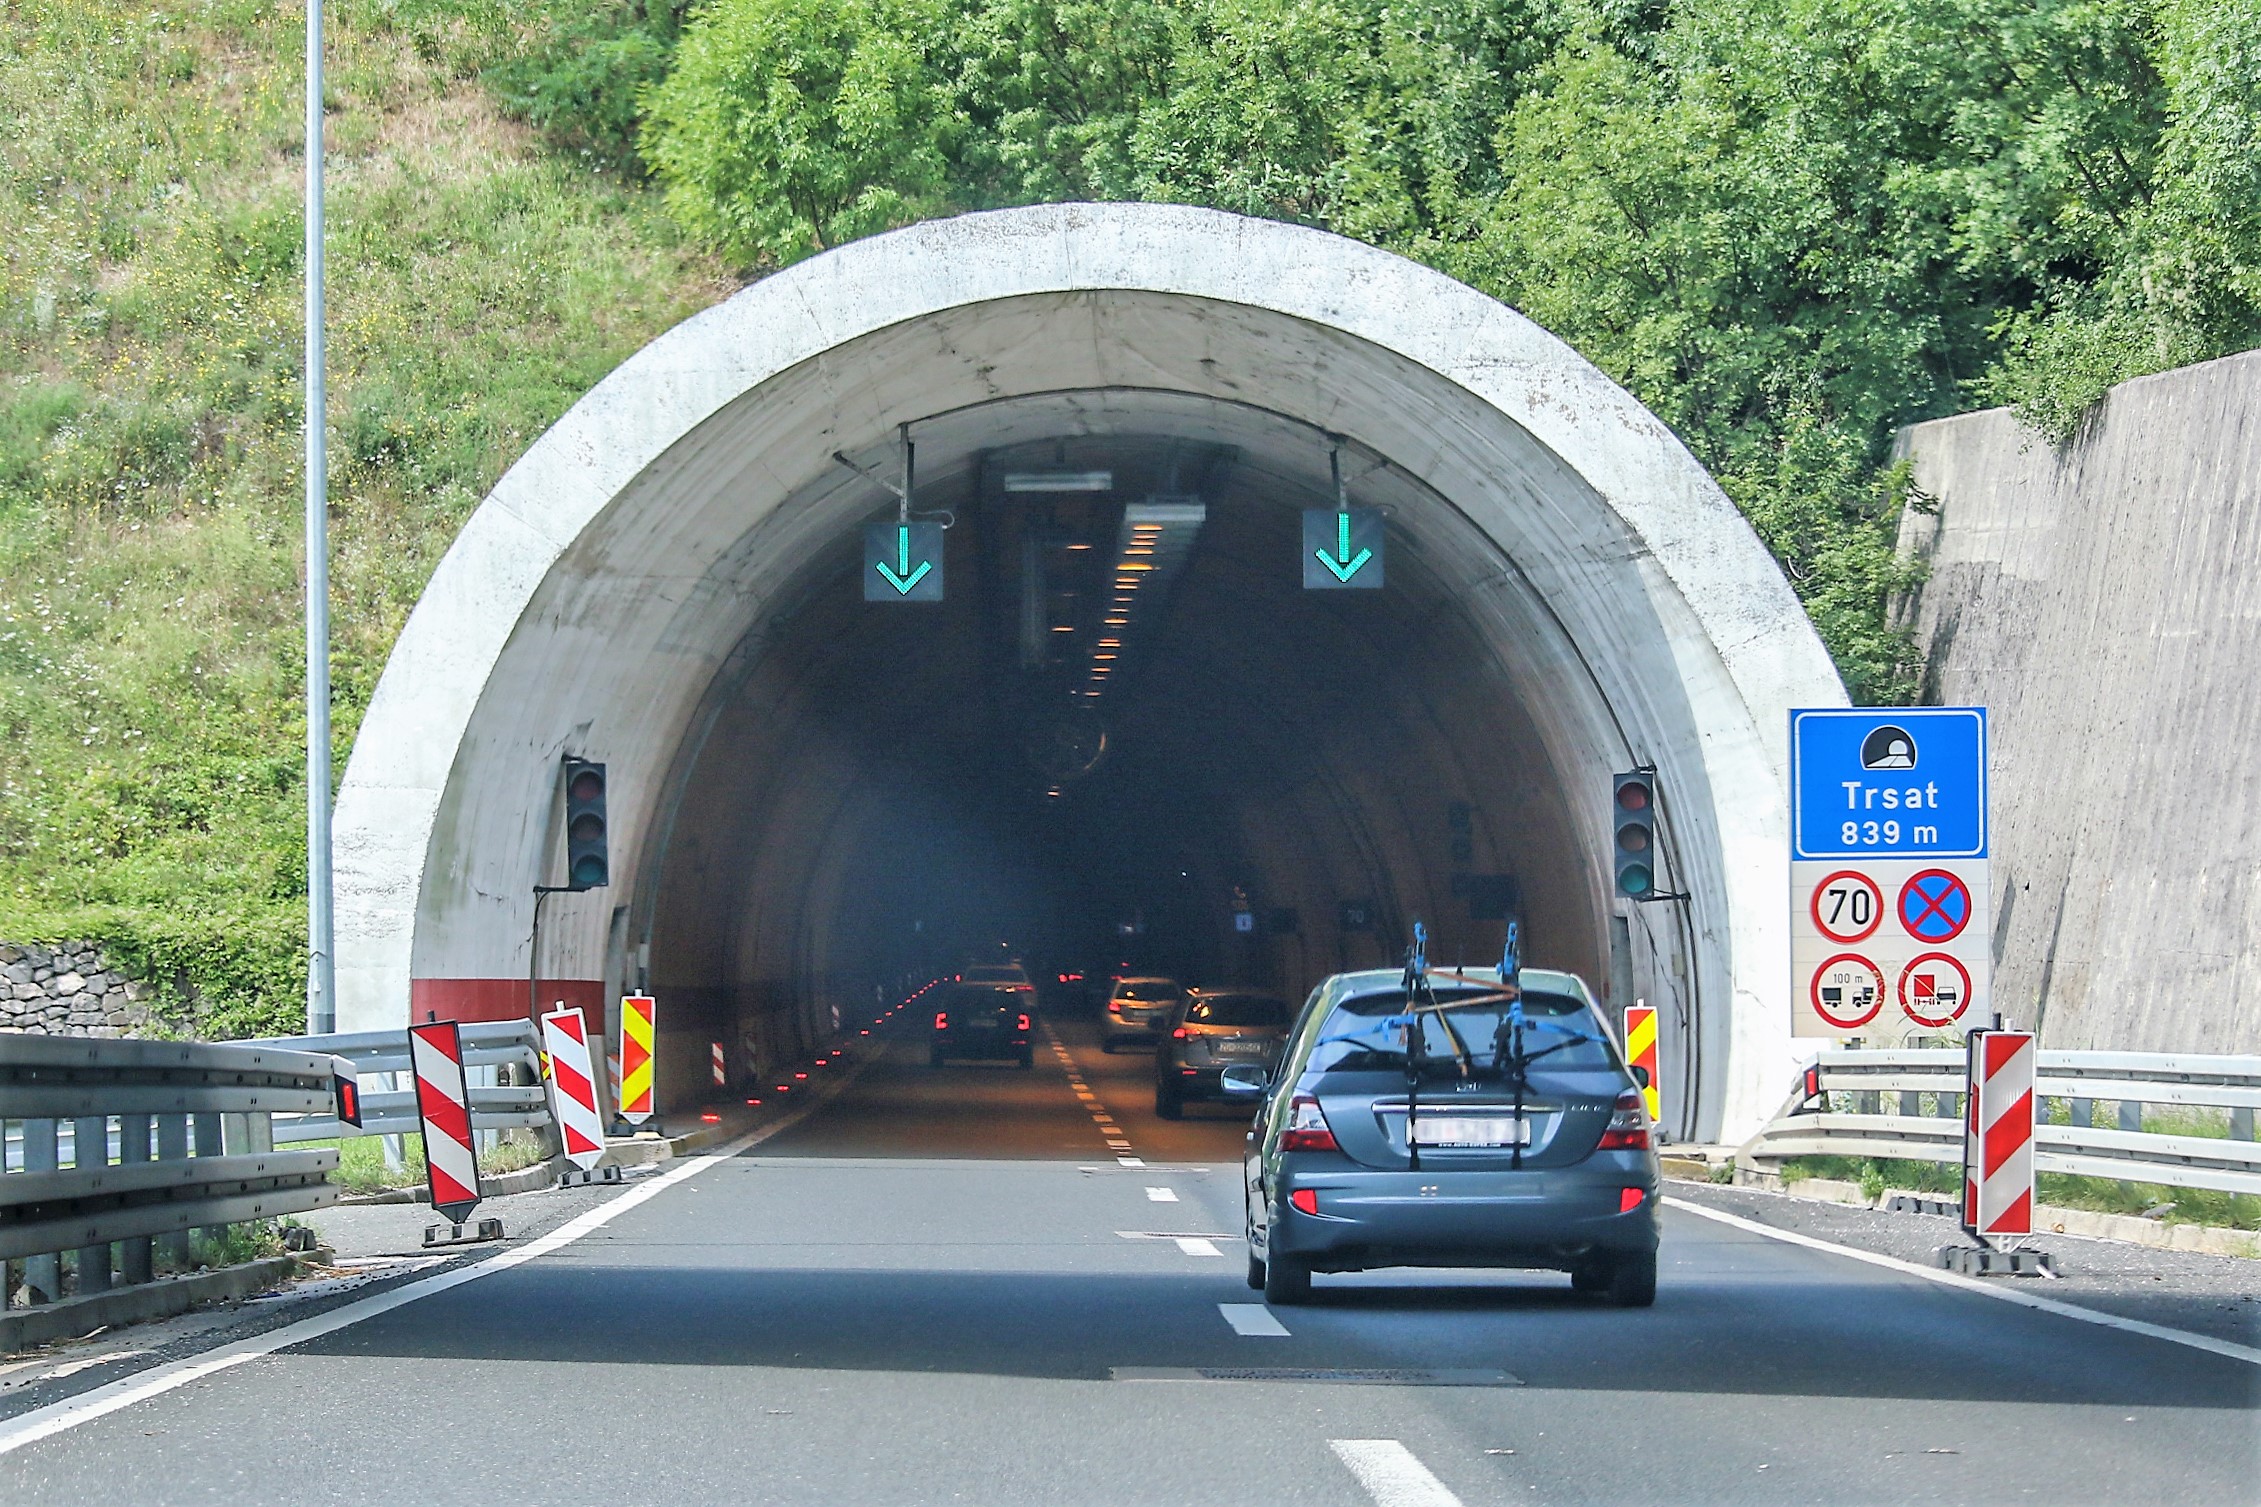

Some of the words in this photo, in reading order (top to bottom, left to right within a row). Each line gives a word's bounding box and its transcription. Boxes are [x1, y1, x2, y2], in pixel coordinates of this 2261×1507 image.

[1841, 781, 1939, 810] Trsat
[1841, 820, 1900, 845] 839
[1913, 825, 1938, 844] m
[1829, 889, 1870, 925] 70
[1834, 972, 1850, 984] 100
[1854, 975, 1863, 984] m
